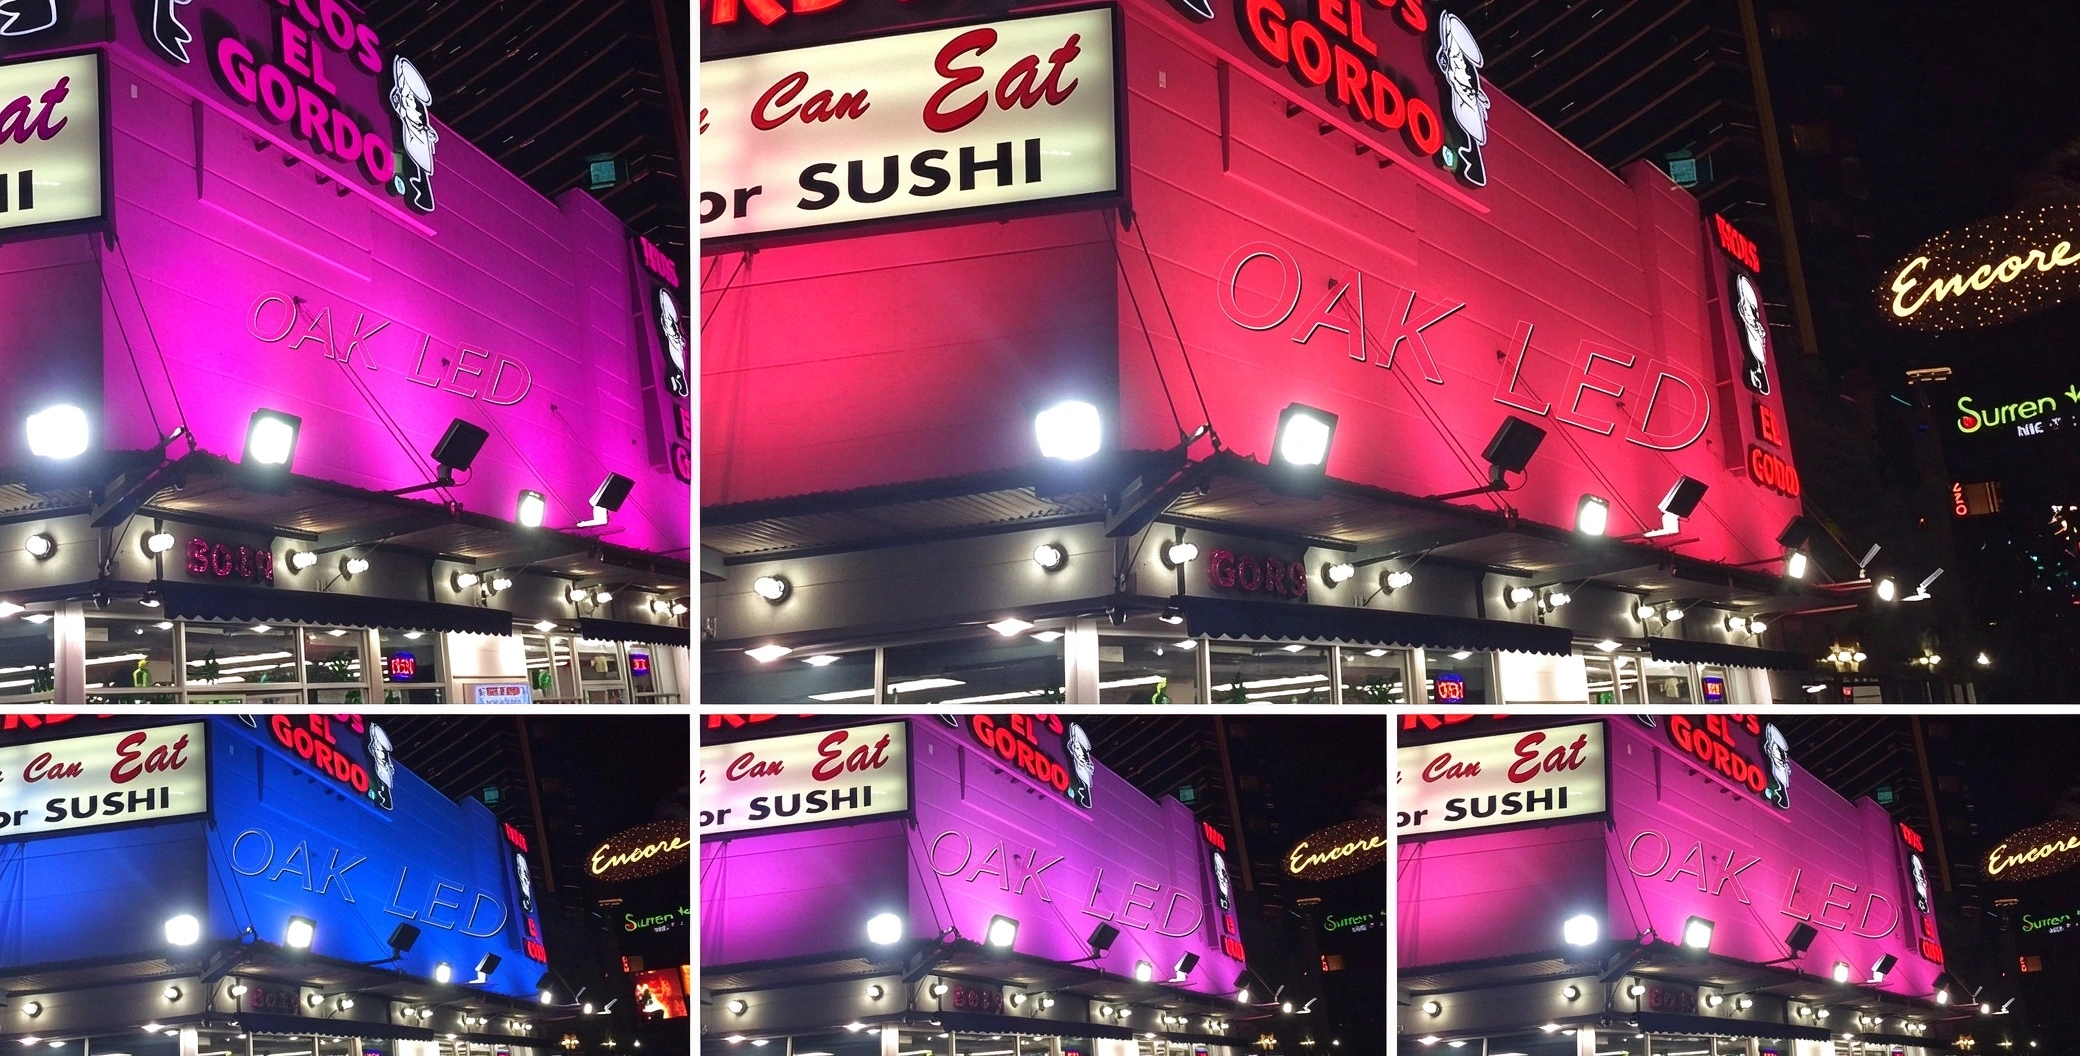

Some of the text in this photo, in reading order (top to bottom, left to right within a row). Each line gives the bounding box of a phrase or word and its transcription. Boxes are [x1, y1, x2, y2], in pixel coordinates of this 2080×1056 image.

[281, 16, 337, 97] EL
[750, 27, 1082, 134] Can Eat
[1246, 0, 1444, 155] GORDO
[217, 37, 395, 184] GORDO
[796, 137, 1042, 211] SUSHI
[1891, 240, 2080, 318] Encore
[23, 731, 190, 784] Can Eat
[271, 714, 370, 792] GORDO
[726, 730, 891, 781] Can Eat
[972, 714, 1069, 791] GORDO
[1421, 731, 1588, 784] Can Eat
[1670, 714, 1766, 792] GORDO
[44, 786, 169, 823] SUSHI
[748, 785, 872, 821] SUSHI
[1444, 786, 1568, 822] SUSHI
[591, 837, 690, 875] Encore
[1290, 836, 1387, 874] Encore
[1988, 836, 2080, 875] Encore
